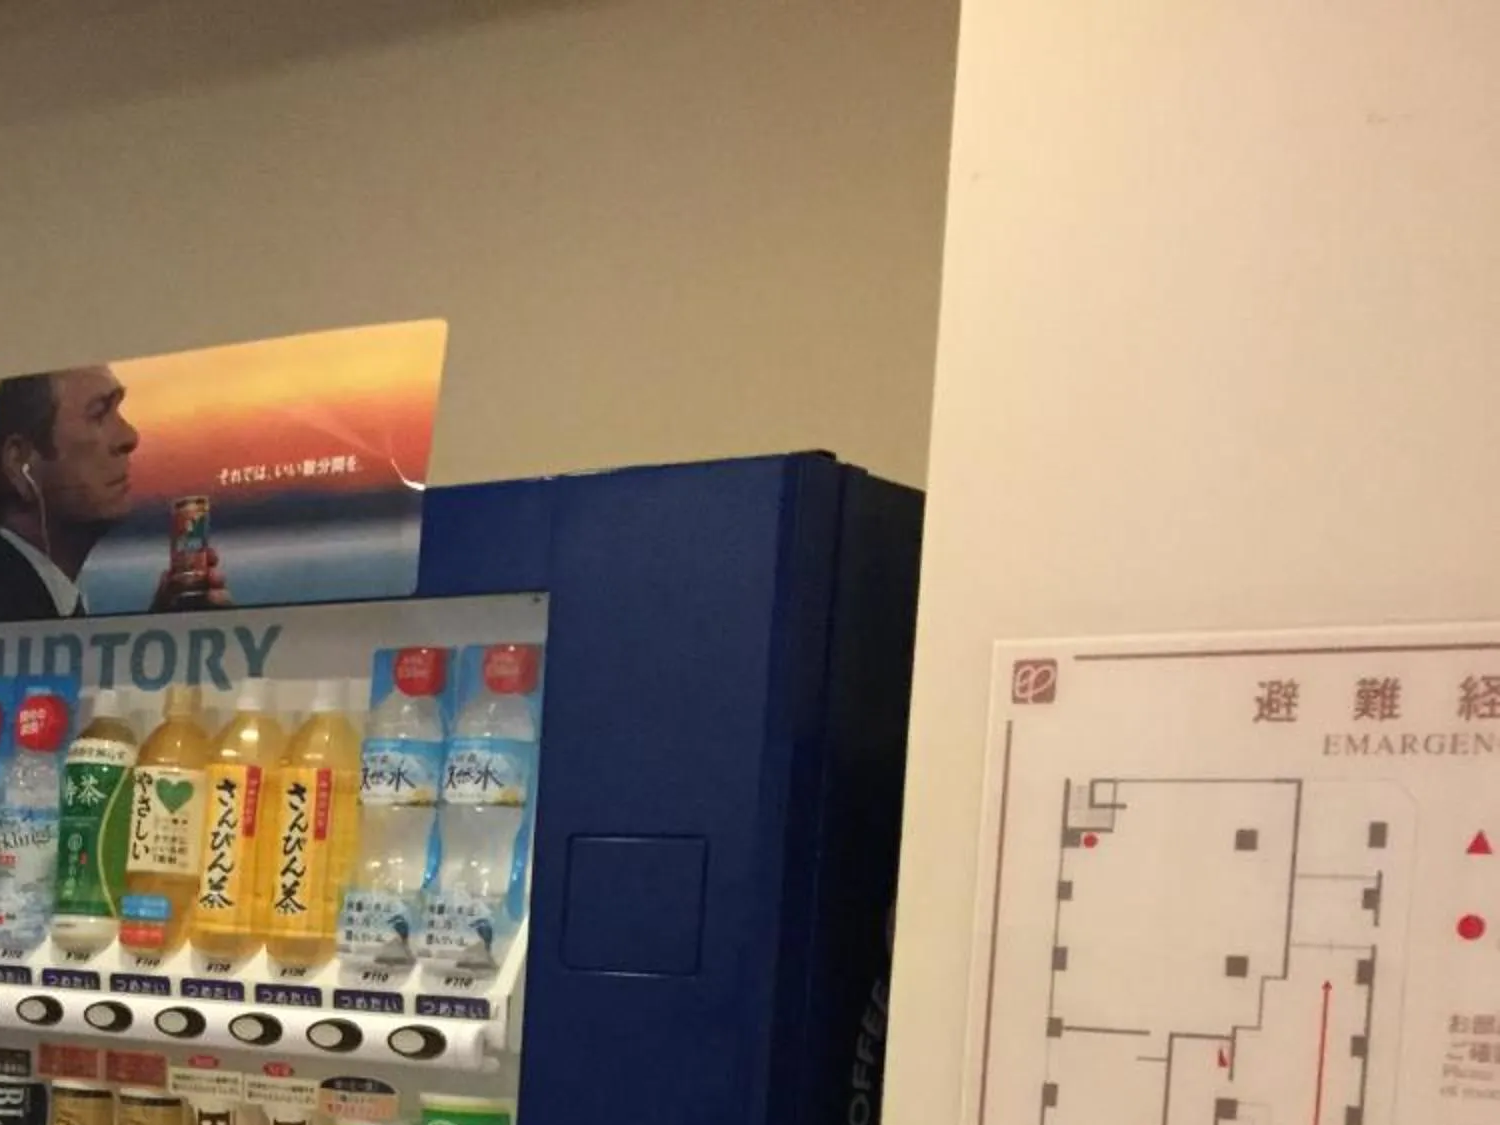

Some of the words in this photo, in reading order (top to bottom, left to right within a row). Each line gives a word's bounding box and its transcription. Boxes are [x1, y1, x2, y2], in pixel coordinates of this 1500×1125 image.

[1322, 731, 1500, 758] EMARGEN
[200, 778, 238, 909] さんびん茶
[274, 782, 309, 914] さんびん茶
